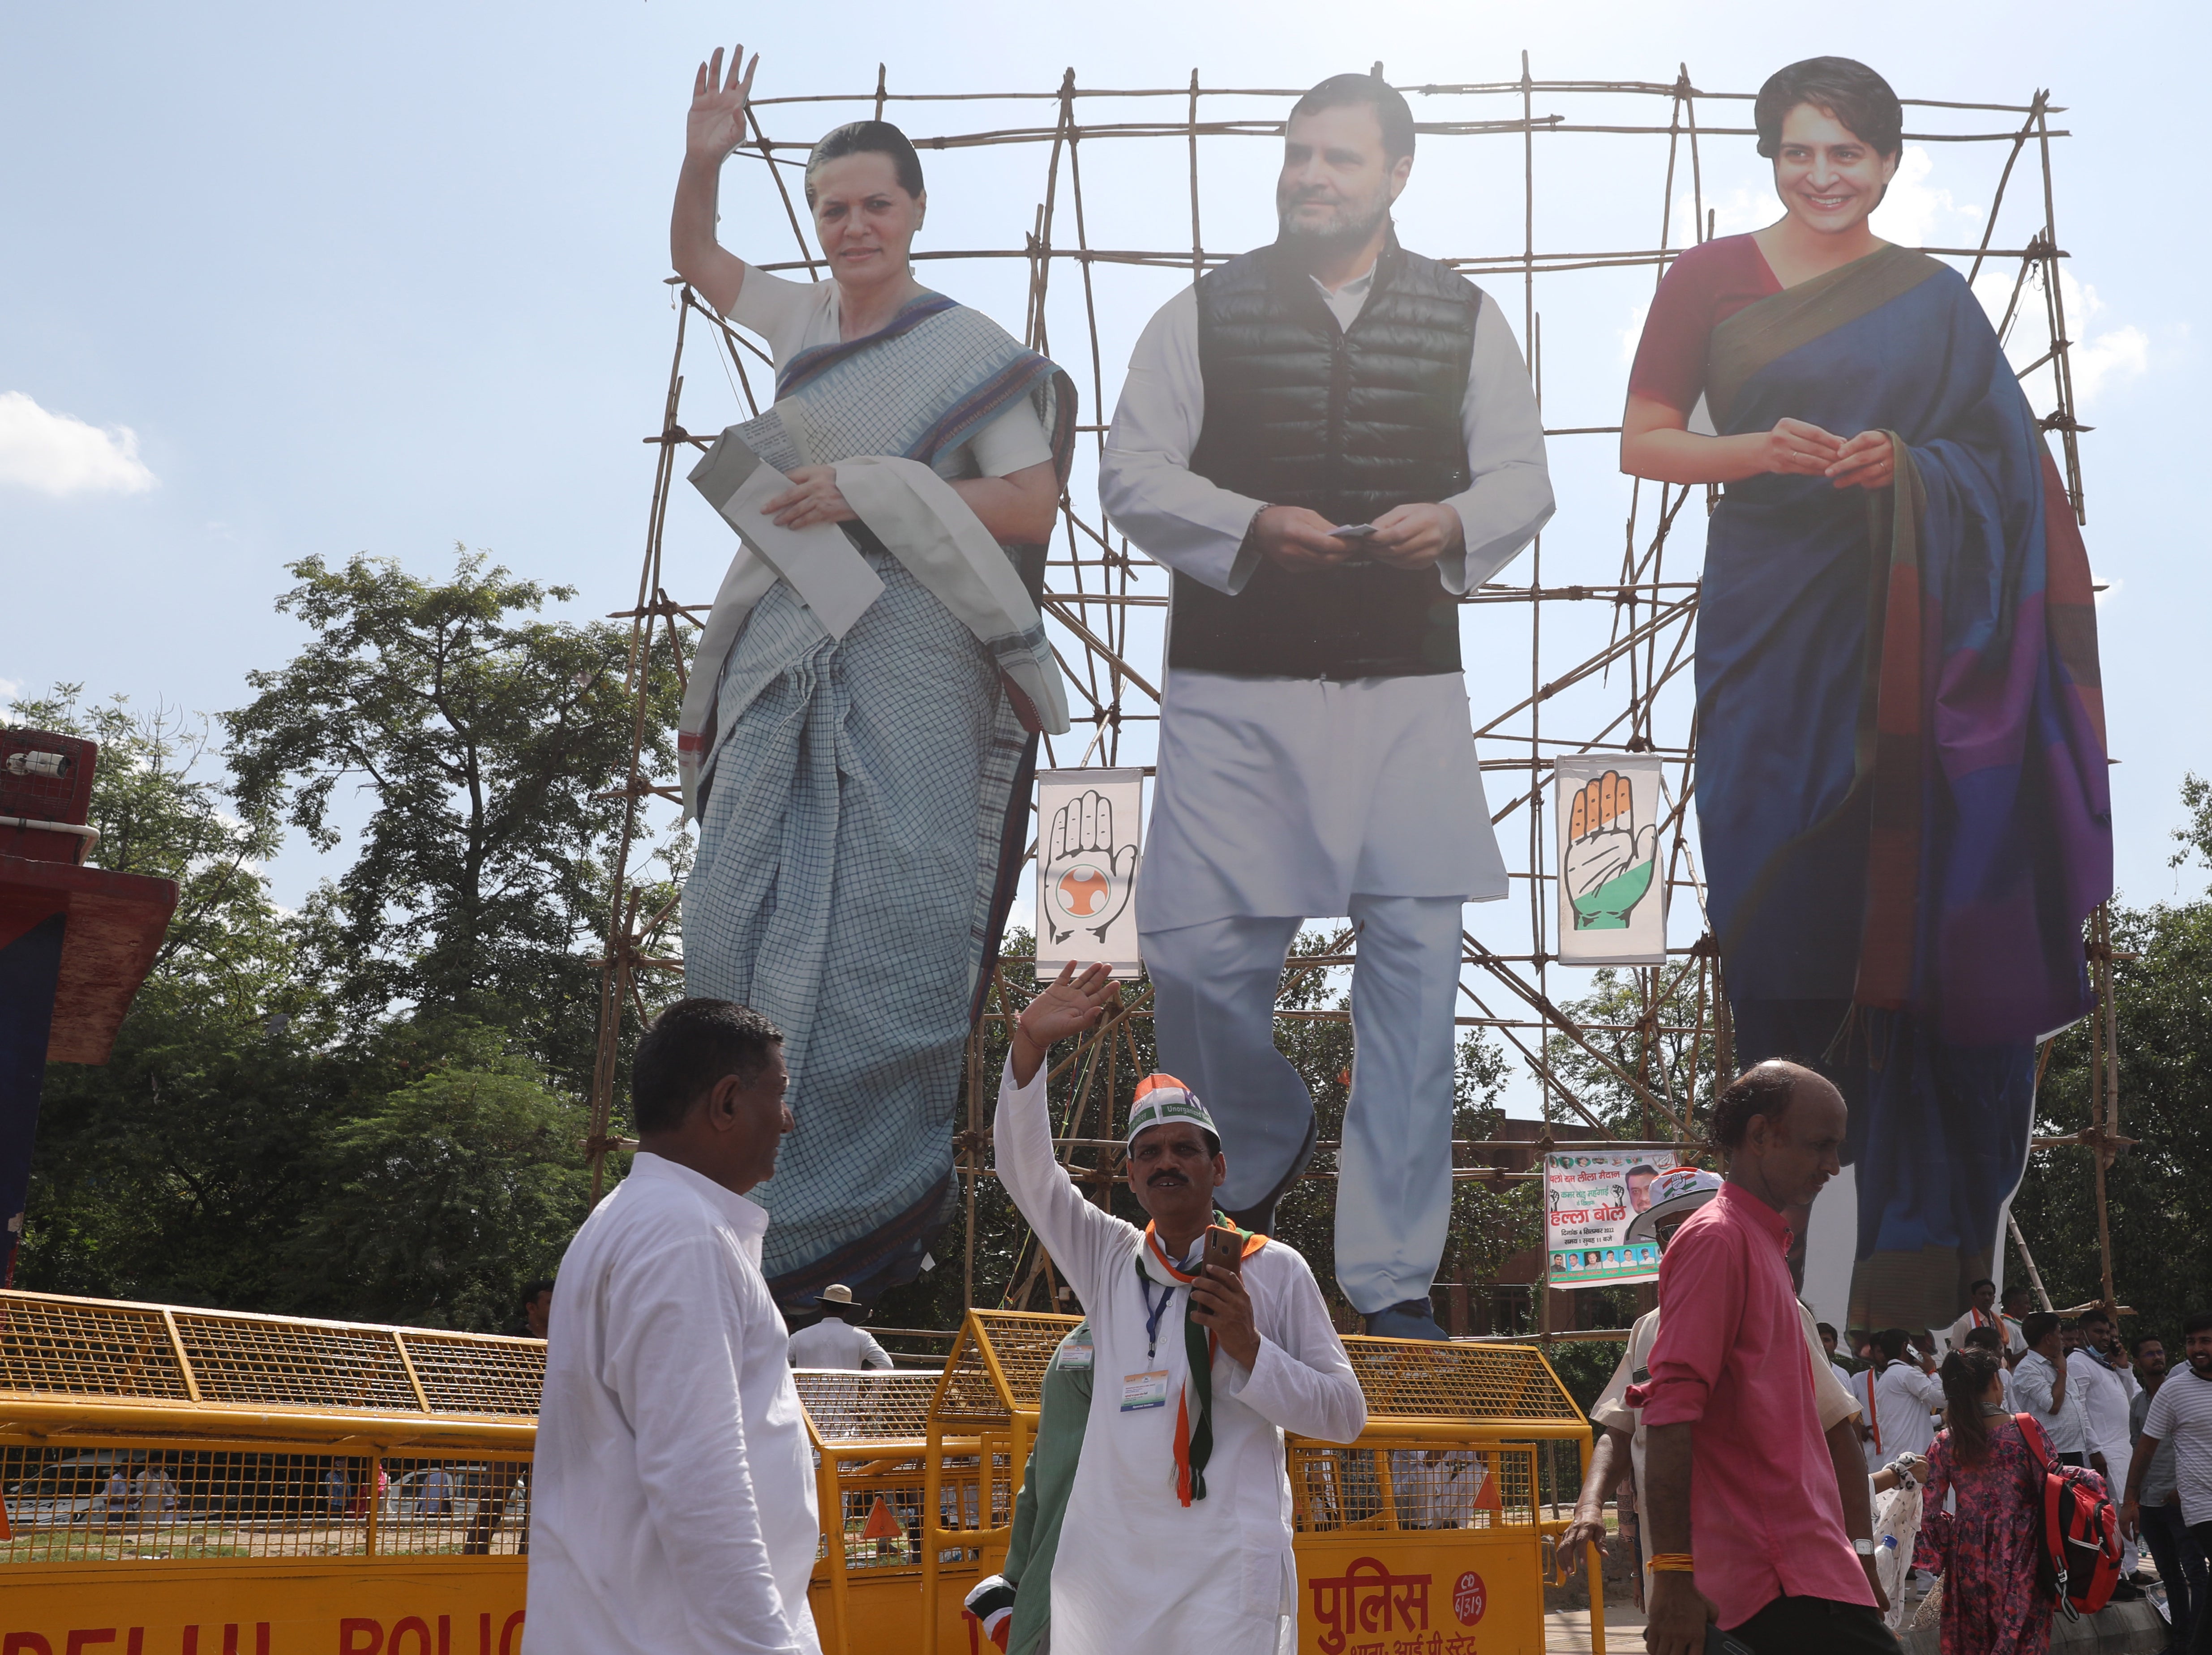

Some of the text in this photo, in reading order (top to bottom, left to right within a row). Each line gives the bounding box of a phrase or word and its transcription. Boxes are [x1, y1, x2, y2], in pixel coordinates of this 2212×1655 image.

[1167, 1106, 1201, 1118] Unorganized
[1549, 1172, 1562, 1183] चलो
[1578, 1171, 1597, 1182] लीला
[1598, 1170, 1620, 1179] मैदान
[1587, 1186, 1609, 1197] महंगाई
[1550, 1202, 1626, 1226] हल्ला बोल
[1309, 1557, 1432, 1655] पुलिस
